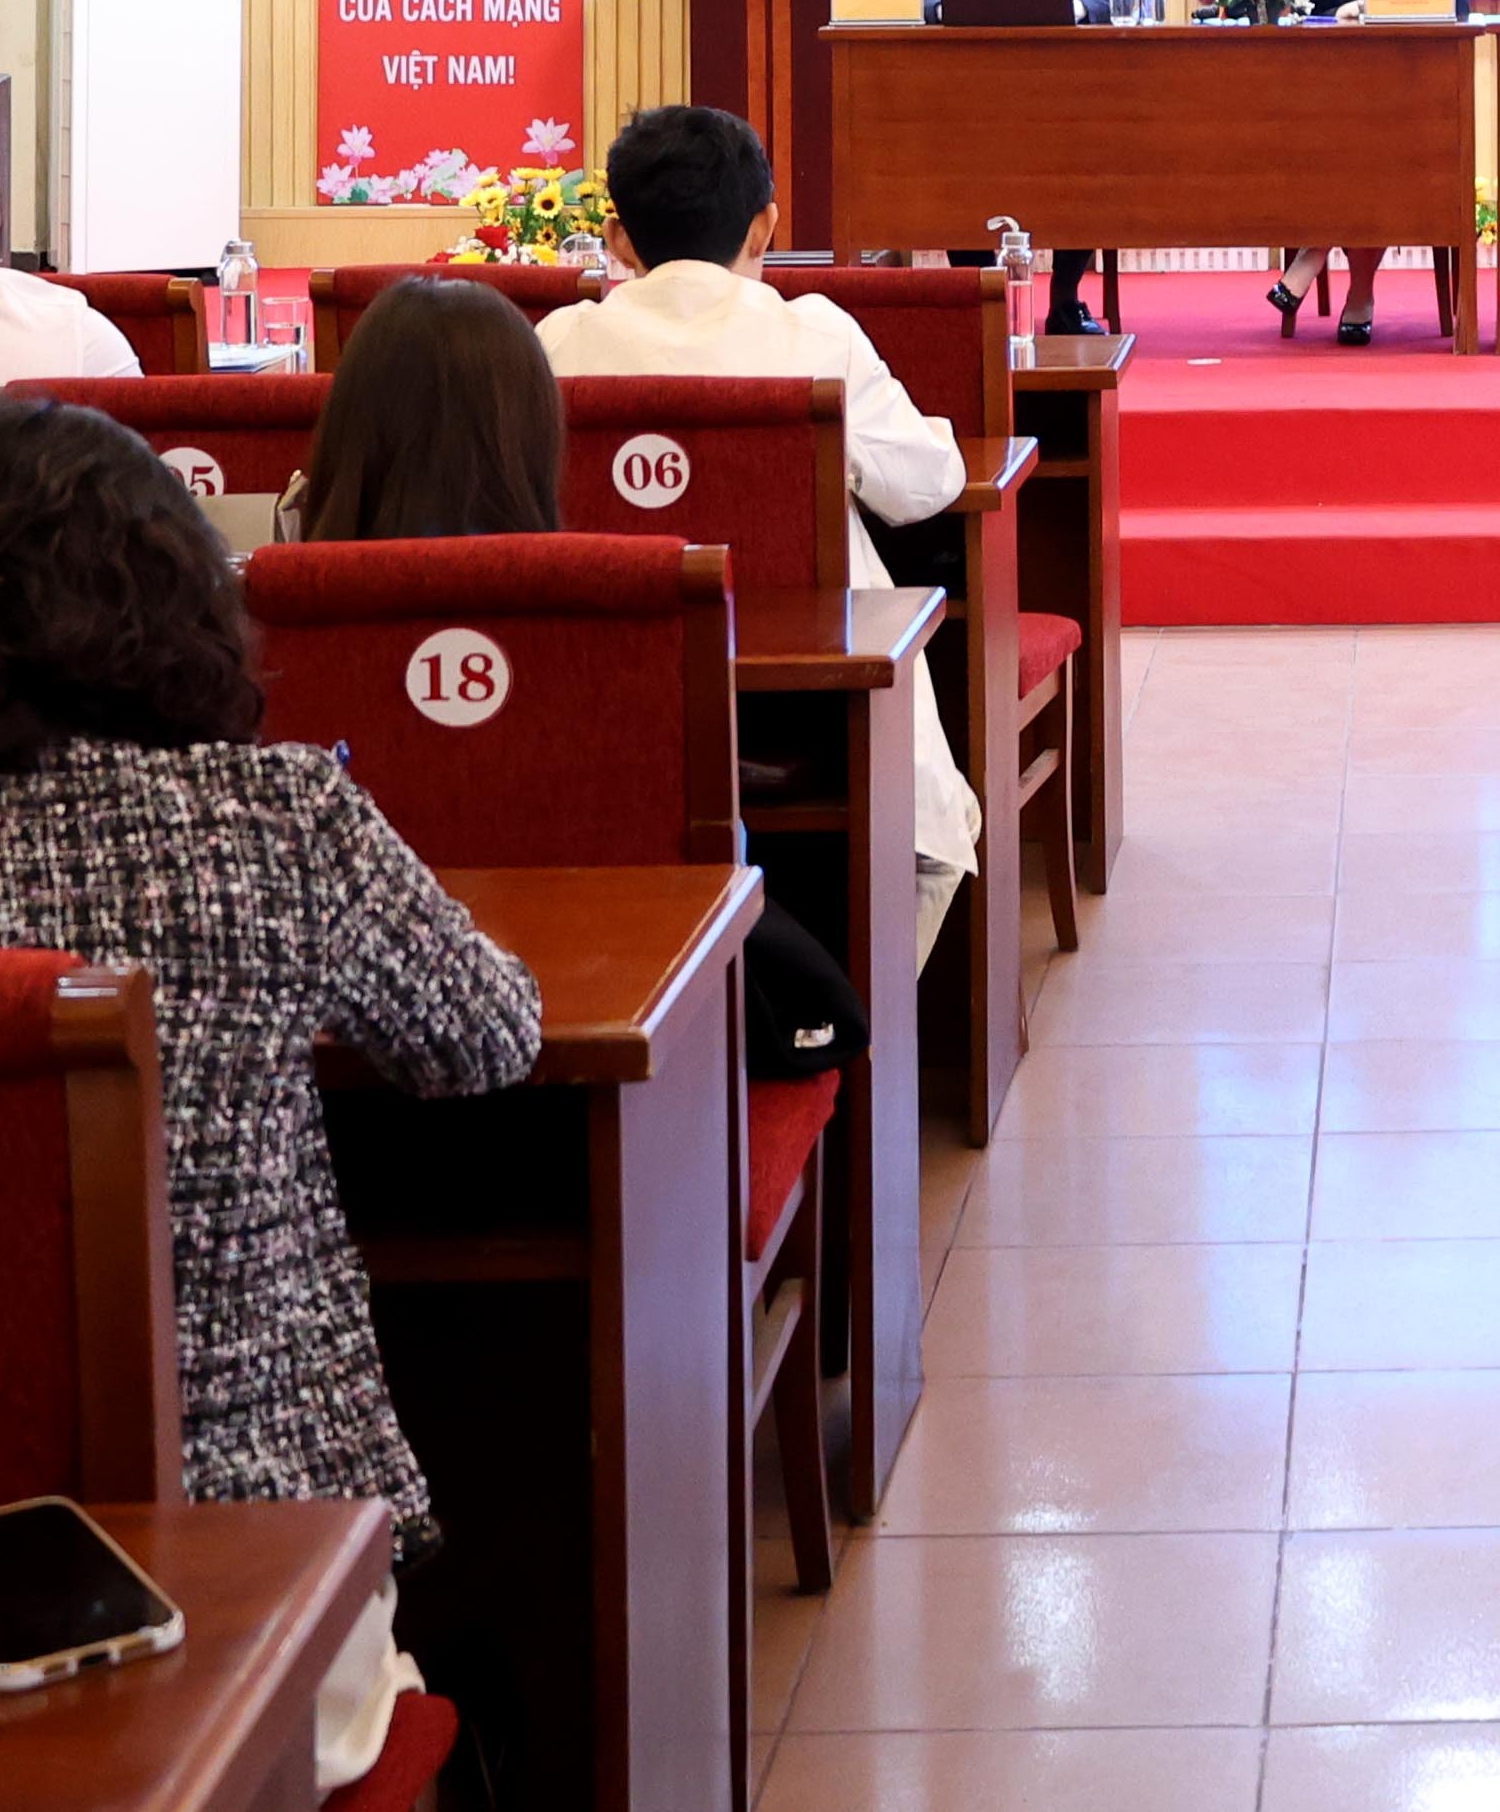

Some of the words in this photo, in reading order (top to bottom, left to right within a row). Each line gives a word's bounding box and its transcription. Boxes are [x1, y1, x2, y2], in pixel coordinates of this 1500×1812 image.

[384, 49, 439, 91] VIỆT
[448, 54, 514, 84] NAM!
[623, 452, 683, 490] 06
[419, 652, 495, 703] 18
